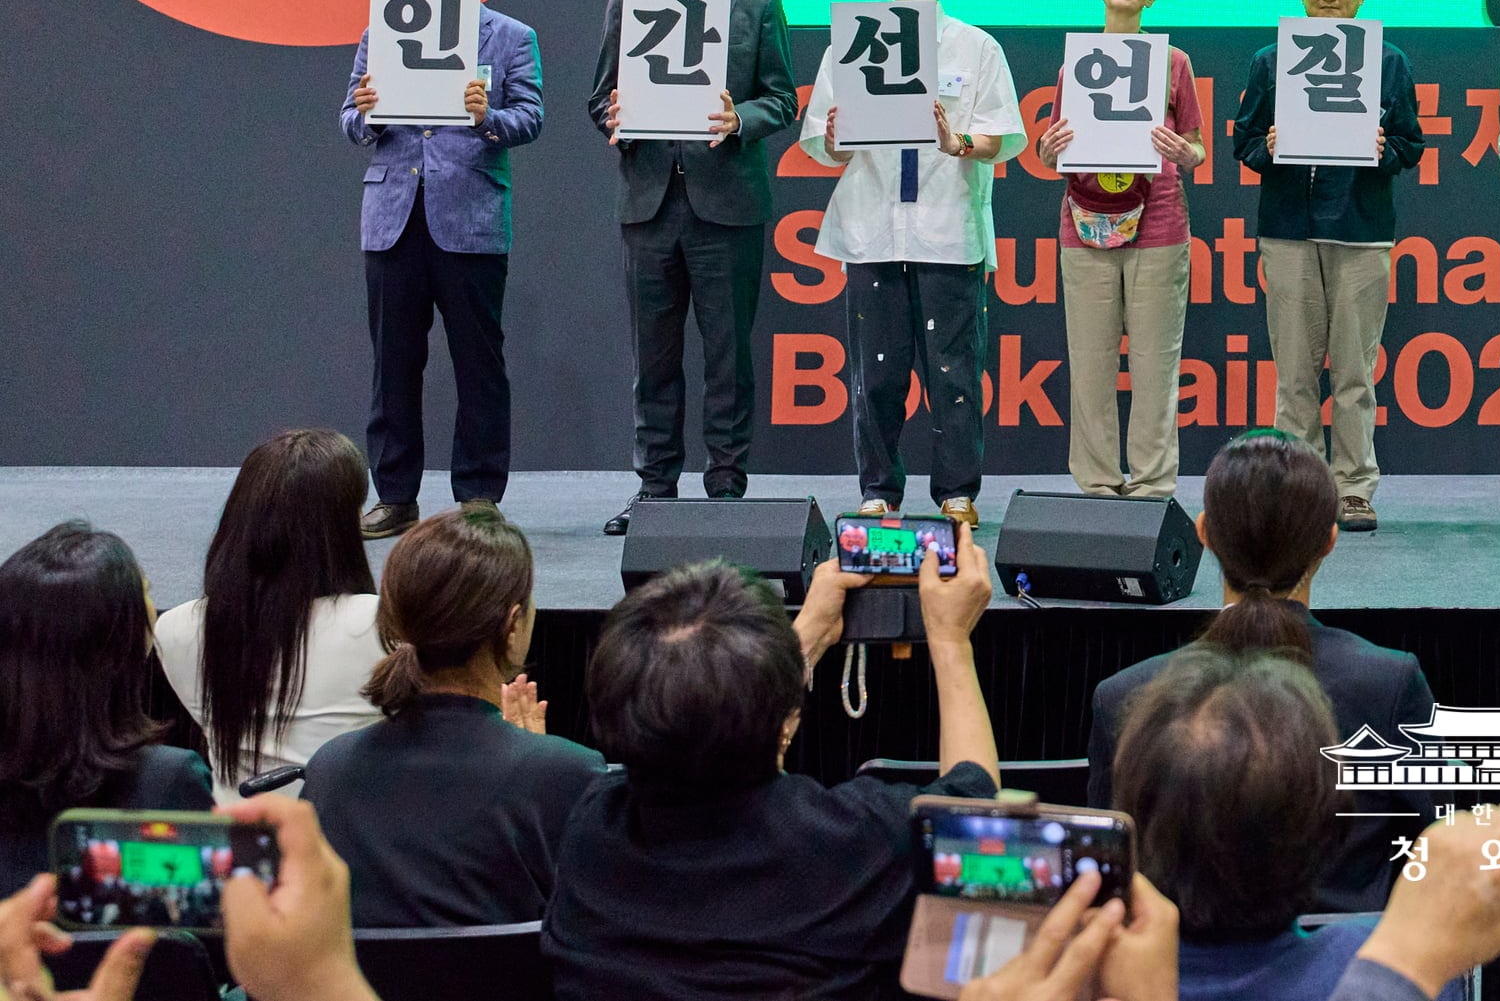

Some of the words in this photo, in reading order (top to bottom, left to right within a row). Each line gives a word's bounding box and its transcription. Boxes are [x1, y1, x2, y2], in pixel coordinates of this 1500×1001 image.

[838, 6, 928, 96] 선
[1074, 39, 1153, 122] 언
[1286, 23, 1368, 114] 질
[770, 333, 1064, 427] Bk
[1116, 334, 1279, 428] air
